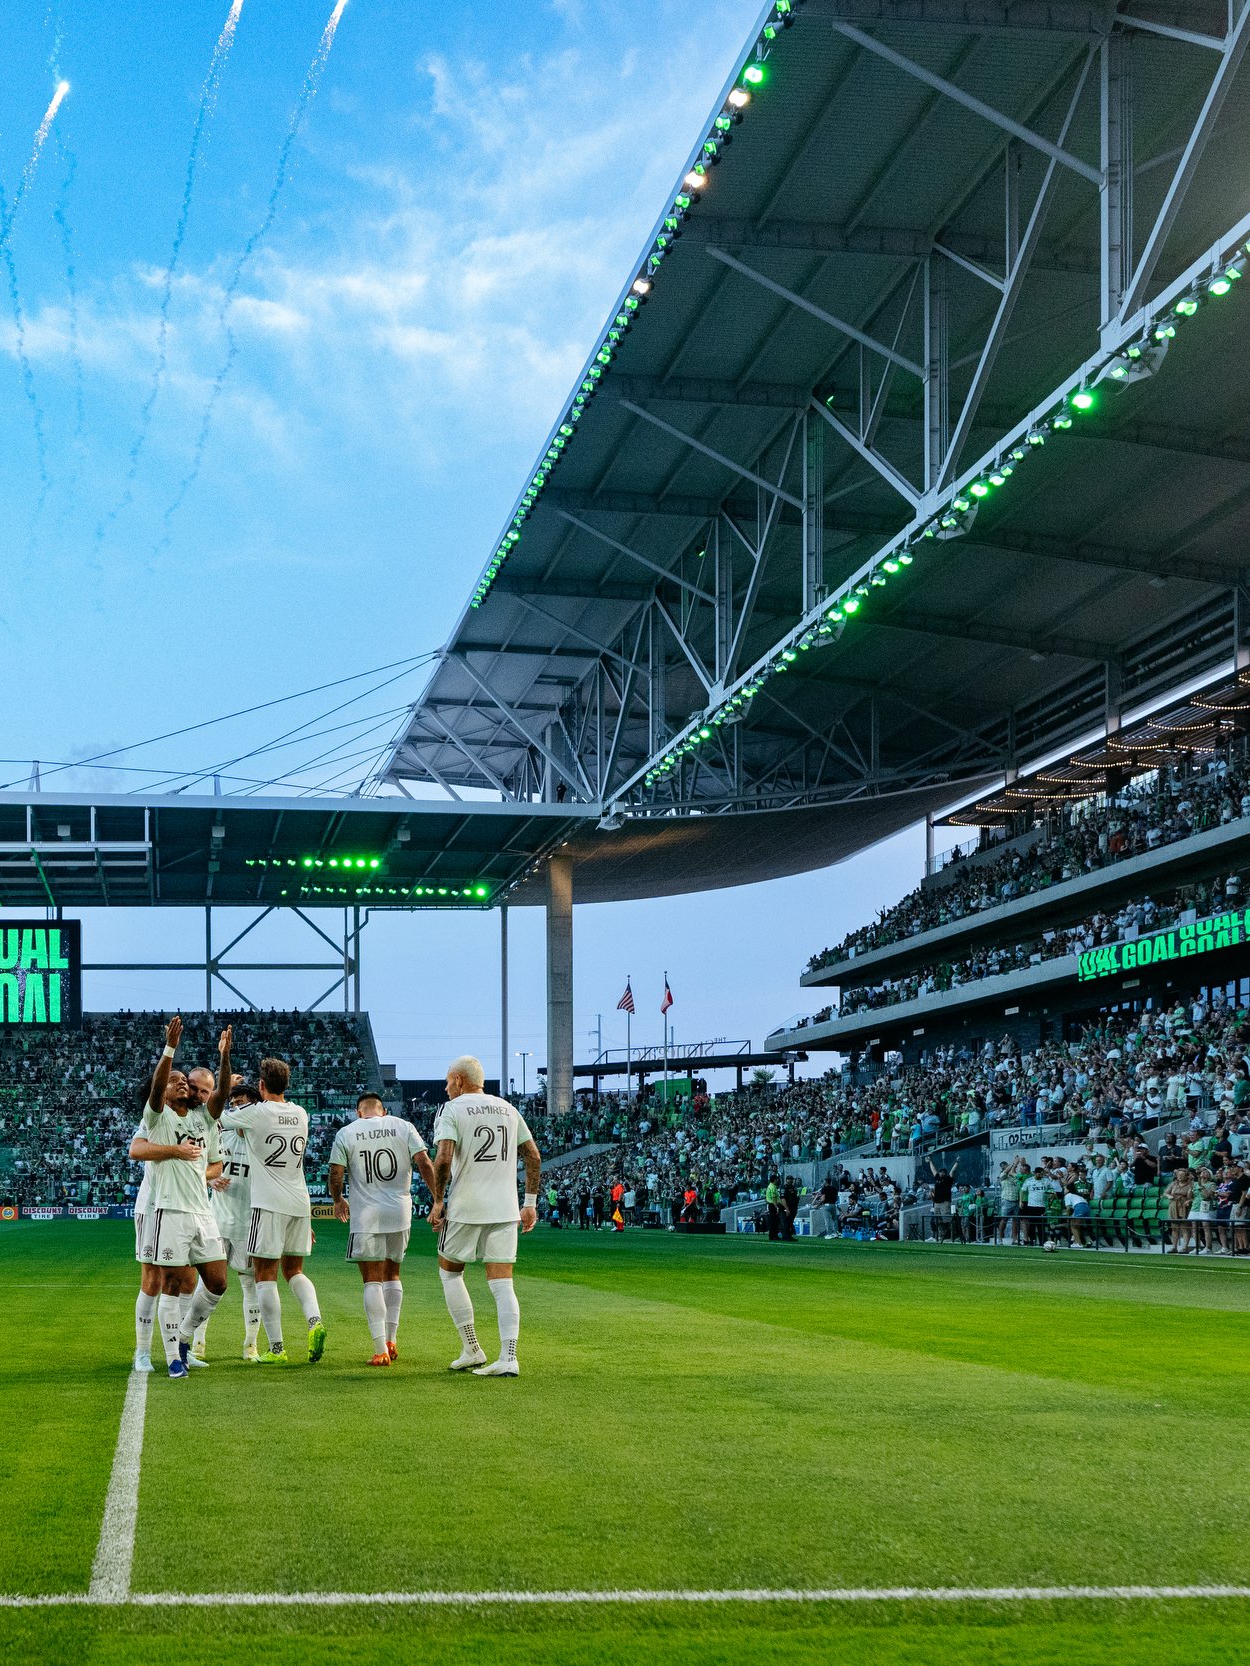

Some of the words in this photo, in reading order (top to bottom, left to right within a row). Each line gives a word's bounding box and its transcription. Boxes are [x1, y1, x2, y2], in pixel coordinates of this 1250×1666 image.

[1122, 932, 1179, 970] GOAL
[278, 1116, 299, 1126] BIRO
[466, 1105, 510, 1116] RAMIREZ
[356, 1132, 367, 1141] M.
[369, 1129, 397, 1139] UZUNI
[473, 1124, 508, 1162] 21
[264, 1133, 306, 1169] 29
[222, 1161, 251, 1178] YET
[359, 1147, 398, 1184] 10
